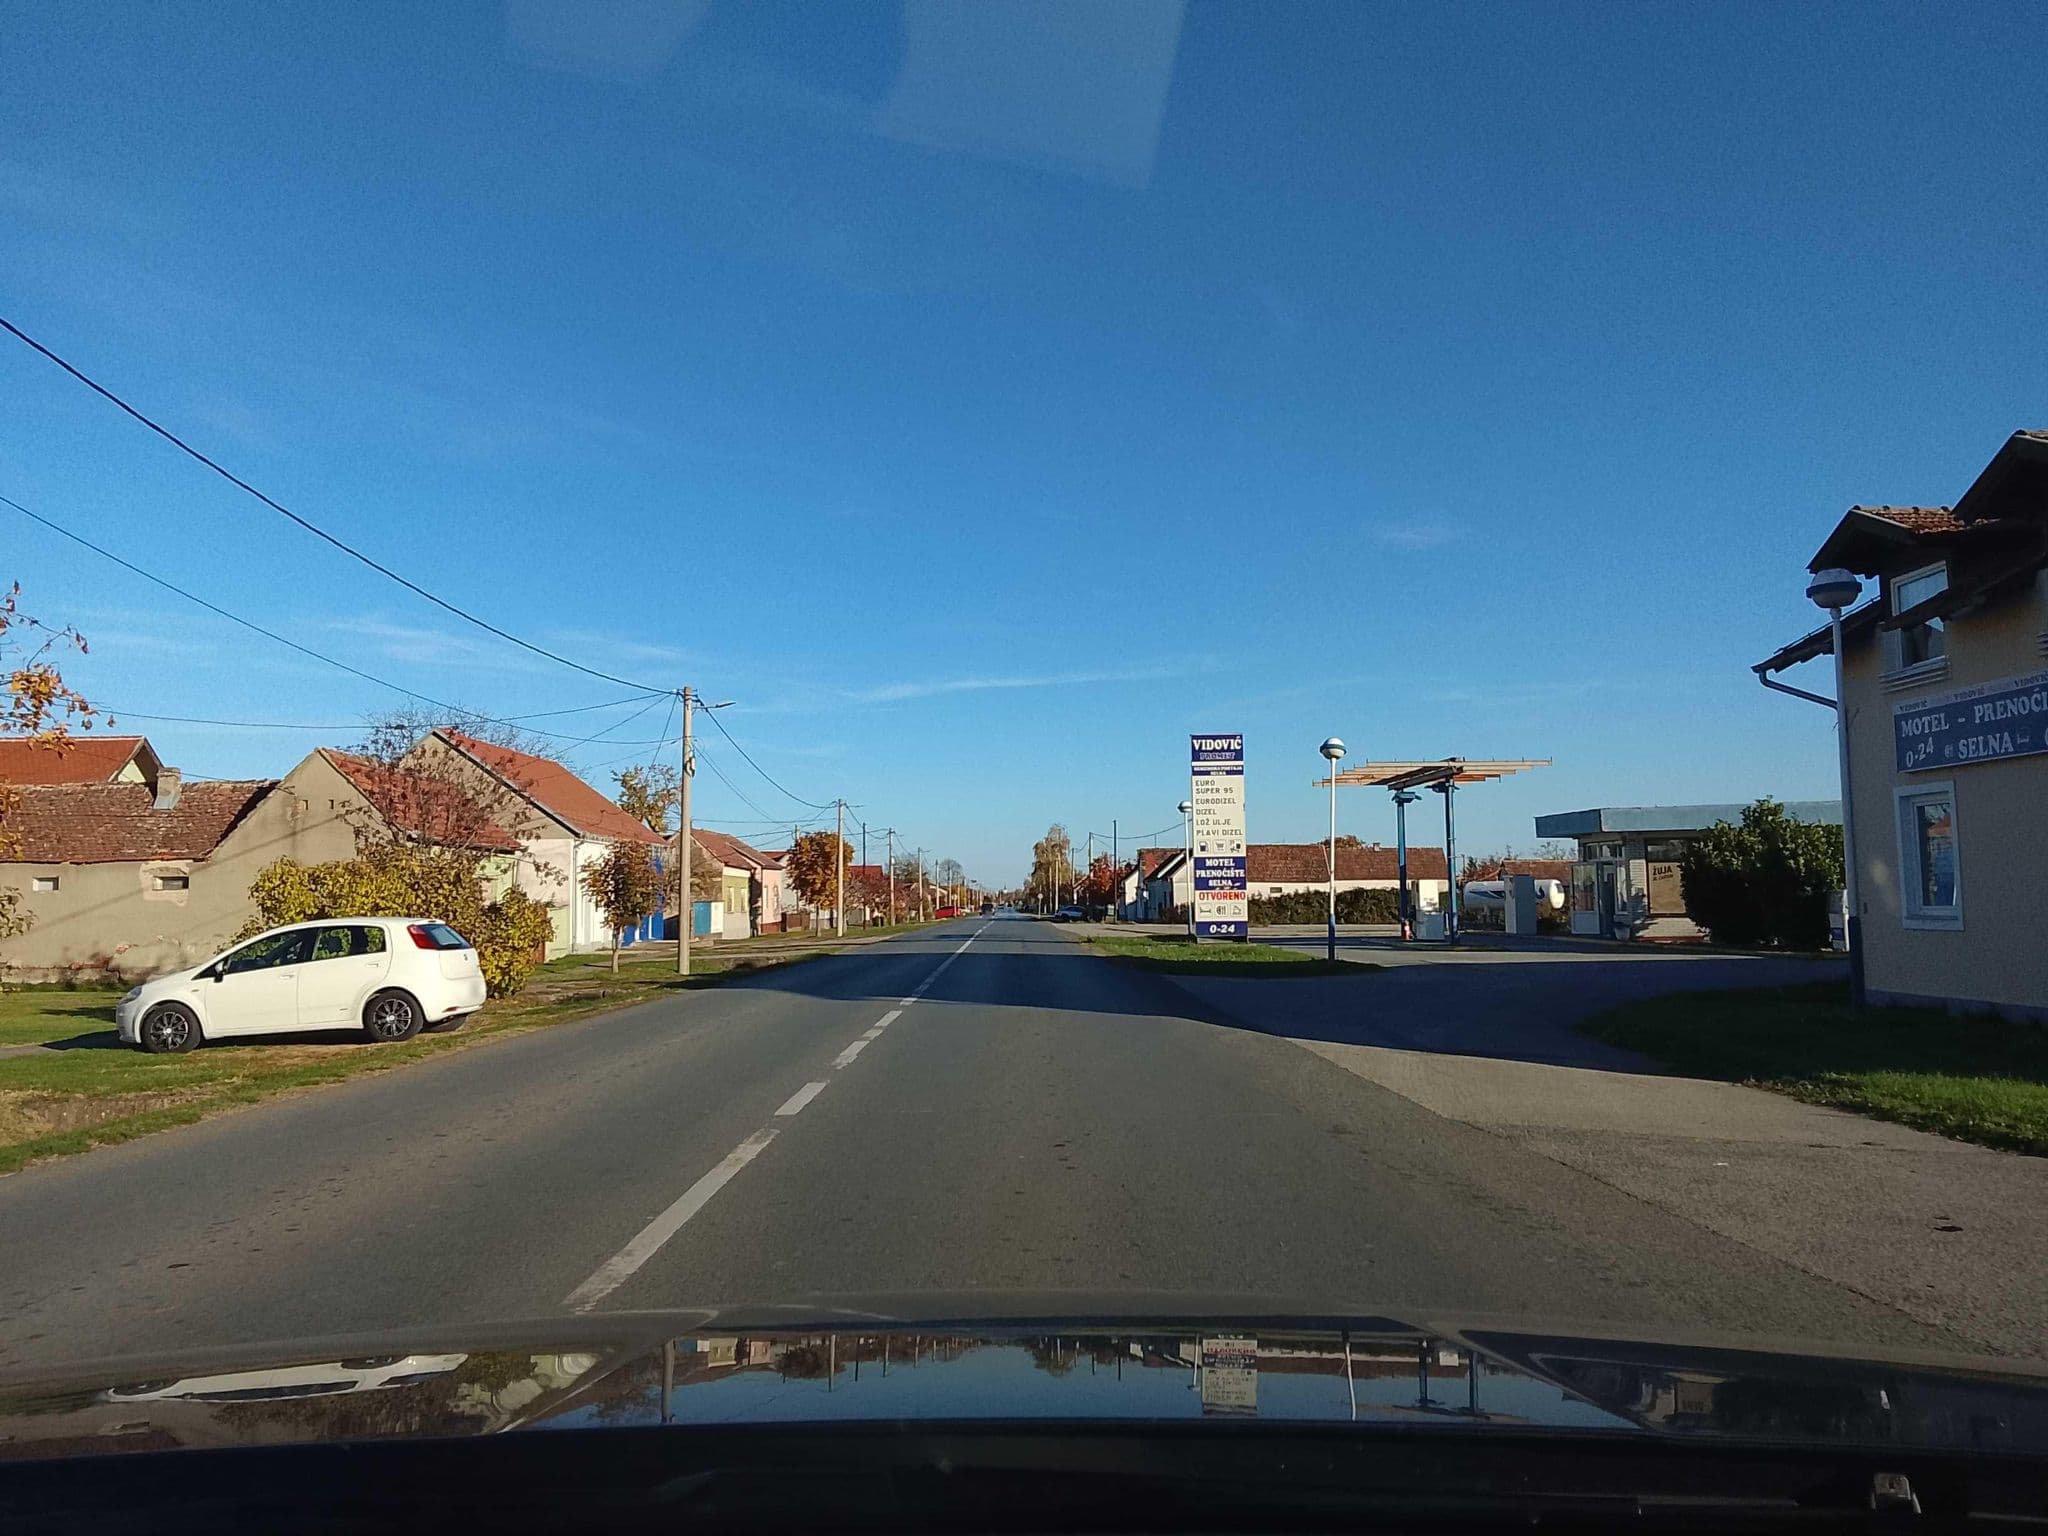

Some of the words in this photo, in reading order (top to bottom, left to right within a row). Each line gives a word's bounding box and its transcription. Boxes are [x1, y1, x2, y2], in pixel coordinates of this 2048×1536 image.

[1901, 713, 1949, 737] MOTEL
[1193, 736, 1242, 751] VIDOVIĆ
[1958, 731, 2014, 760] SELNA
[1195, 787, 1220, 795] SUPER
[1196, 818, 1211, 826] LOŽ
[1212, 818, 1232, 826] ULJE
[1205, 858, 1235, 867] MOTEL
[1208, 879, 1233, 887] SELNA
[1199, 891, 1246, 901] OTVORENO
[1209, 924, 1236, 933] 0-24
